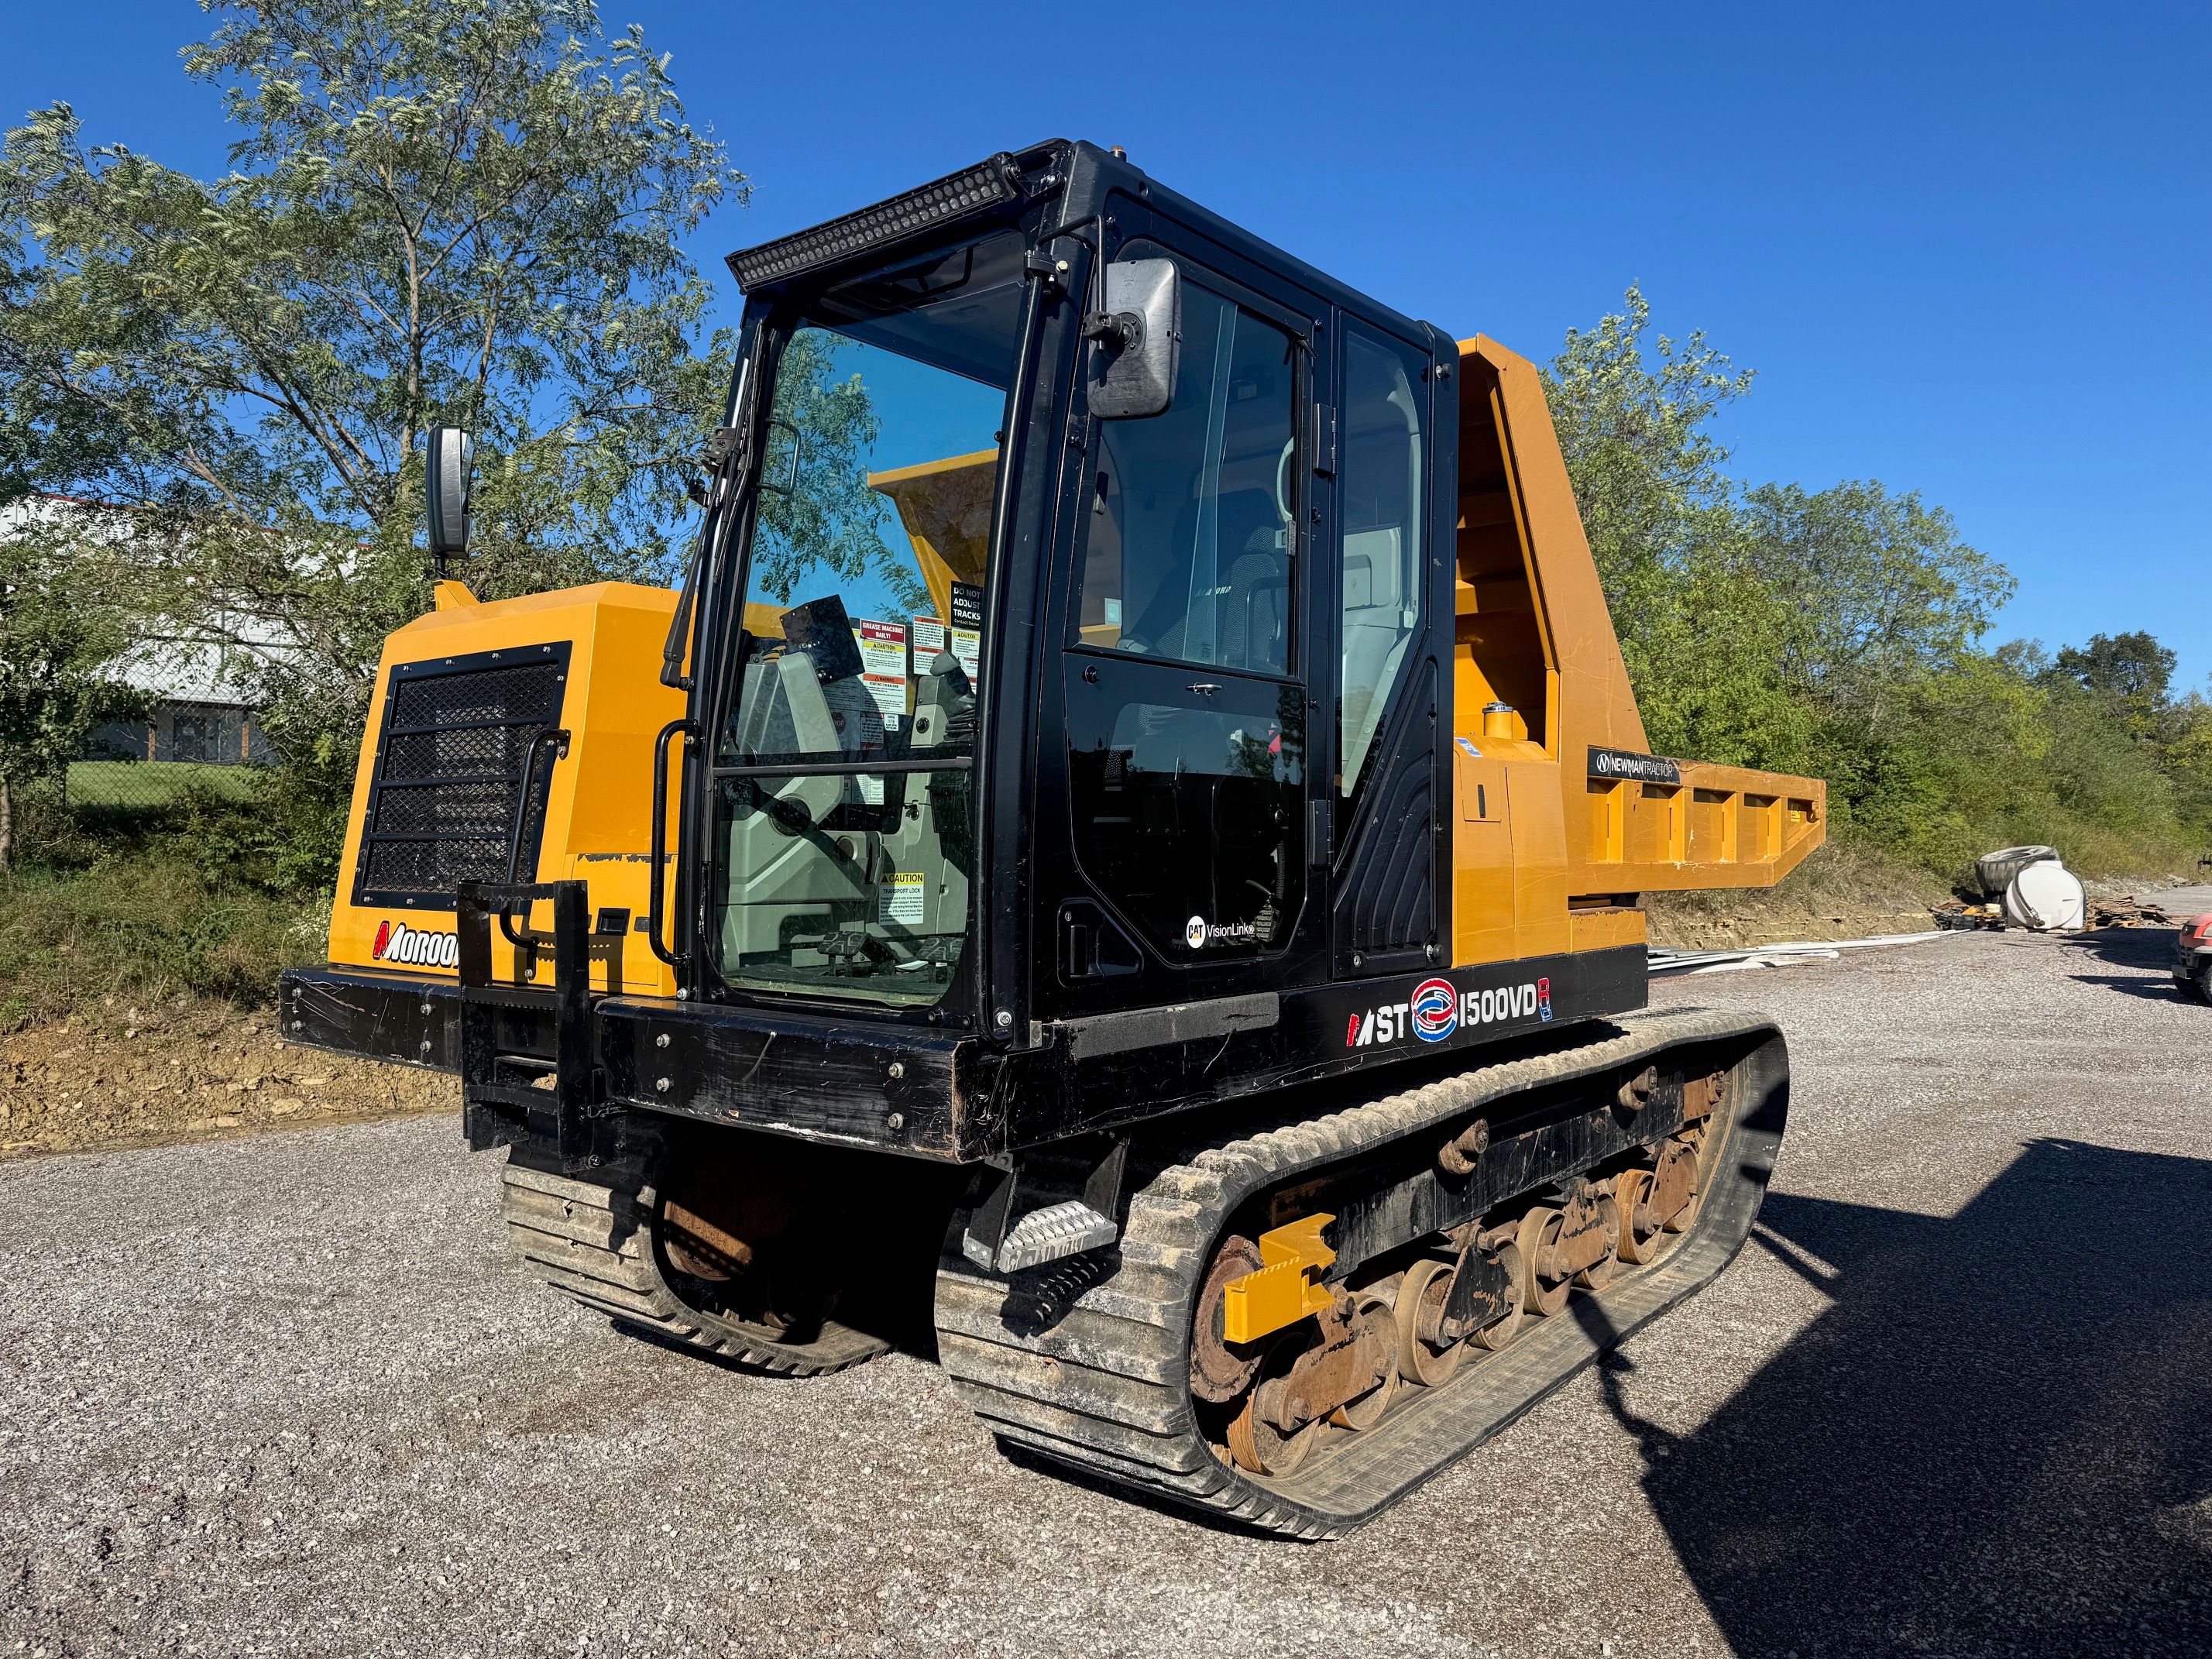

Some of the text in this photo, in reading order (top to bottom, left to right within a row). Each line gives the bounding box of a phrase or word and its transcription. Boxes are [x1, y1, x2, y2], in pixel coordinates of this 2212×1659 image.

[953, 586, 981, 599] DO NOT
[953, 597, 981, 610] ADJUST
[953, 608, 981, 620] TRACKS
[862, 622, 904, 634] GREASE MACHINE
[888, 874, 923, 883] CAUTION
[1188, 924, 1204, 939] CAT
